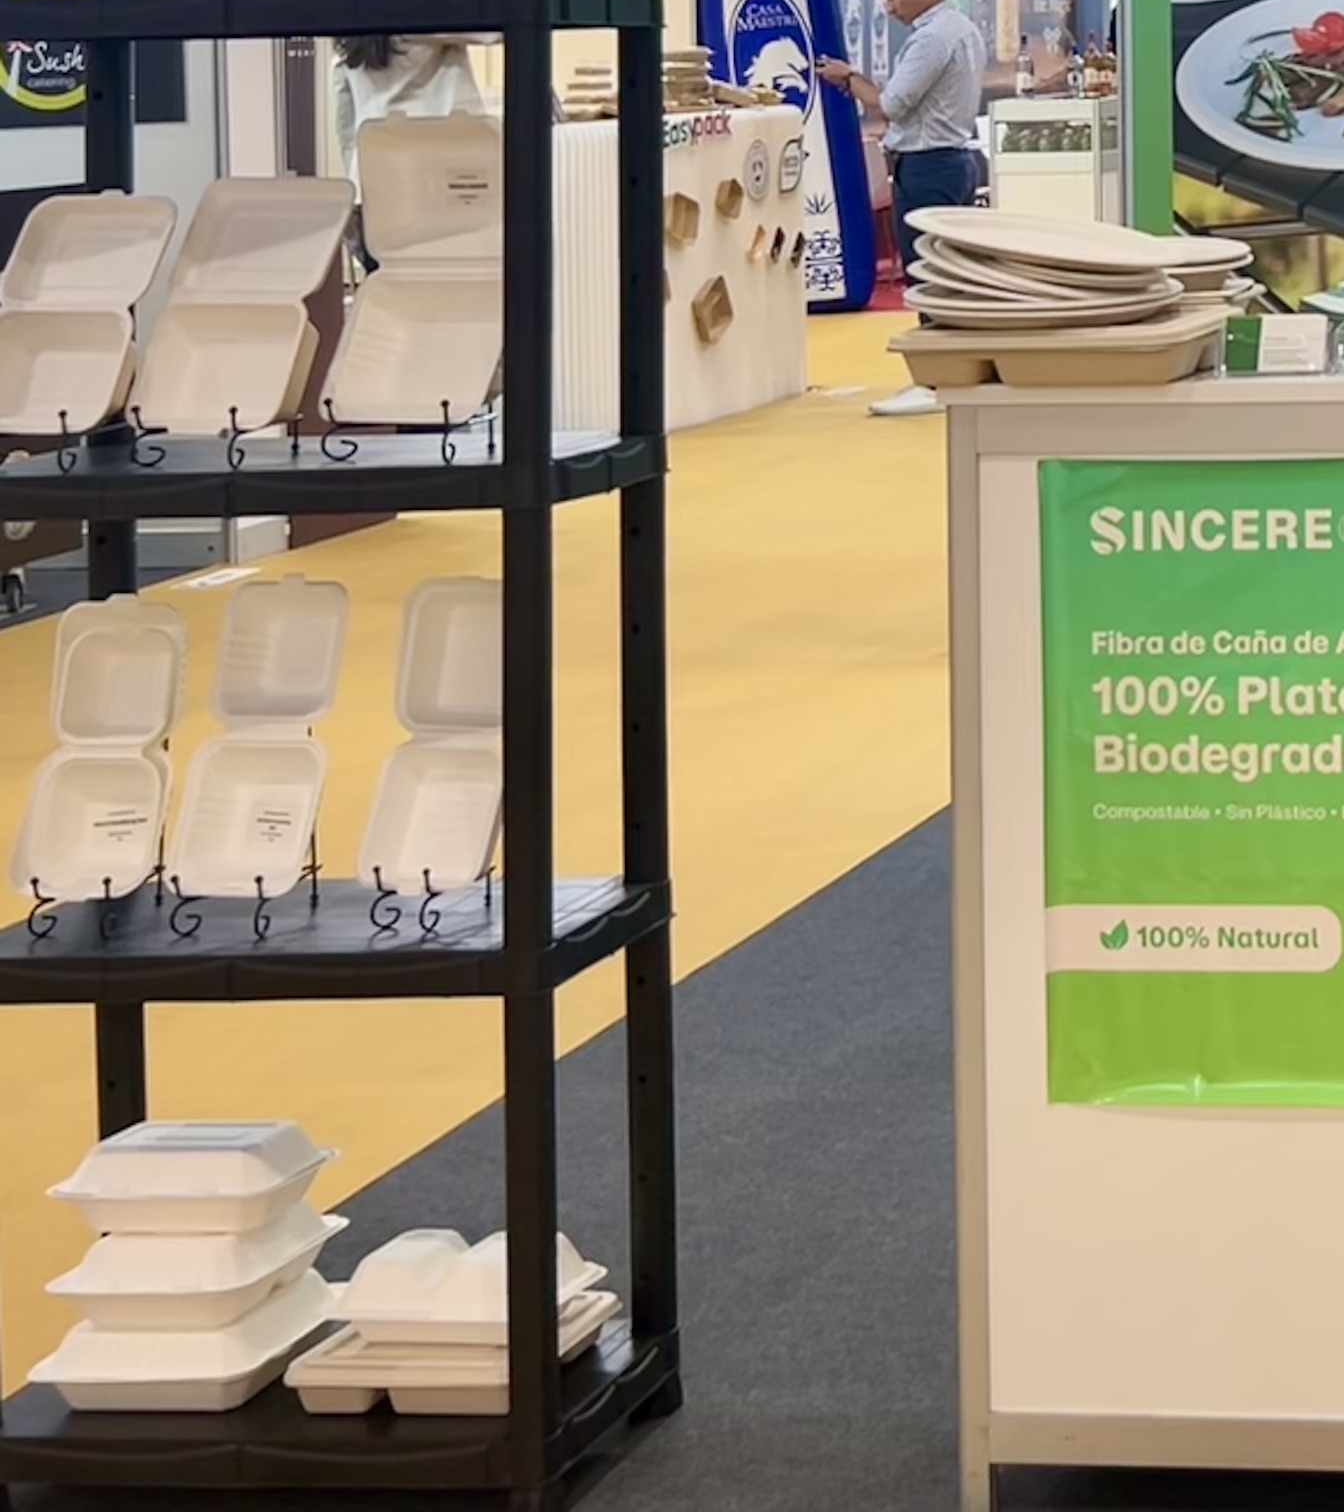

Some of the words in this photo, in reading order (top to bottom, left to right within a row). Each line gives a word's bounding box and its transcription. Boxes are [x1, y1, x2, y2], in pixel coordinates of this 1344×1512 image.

[26, 40, 86, 74] Sush
[1090, 505, 1333, 555] SINCERE
[1091, 630, 1165, 656] Fibra
[1170, 630, 1206, 656] de
[1212, 628, 1287, 656] Caña
[1293, 629, 1329, 655] de
[1092, 674, 1226, 717] 100%
[1092, 802, 1211, 822] Compostable
[1225, 802, 1253, 820] Sin
[1255, 802, 1327, 821] Plástico
[1135, 925, 1210, 950] 100%
[1217, 925, 1320, 950] Natural
